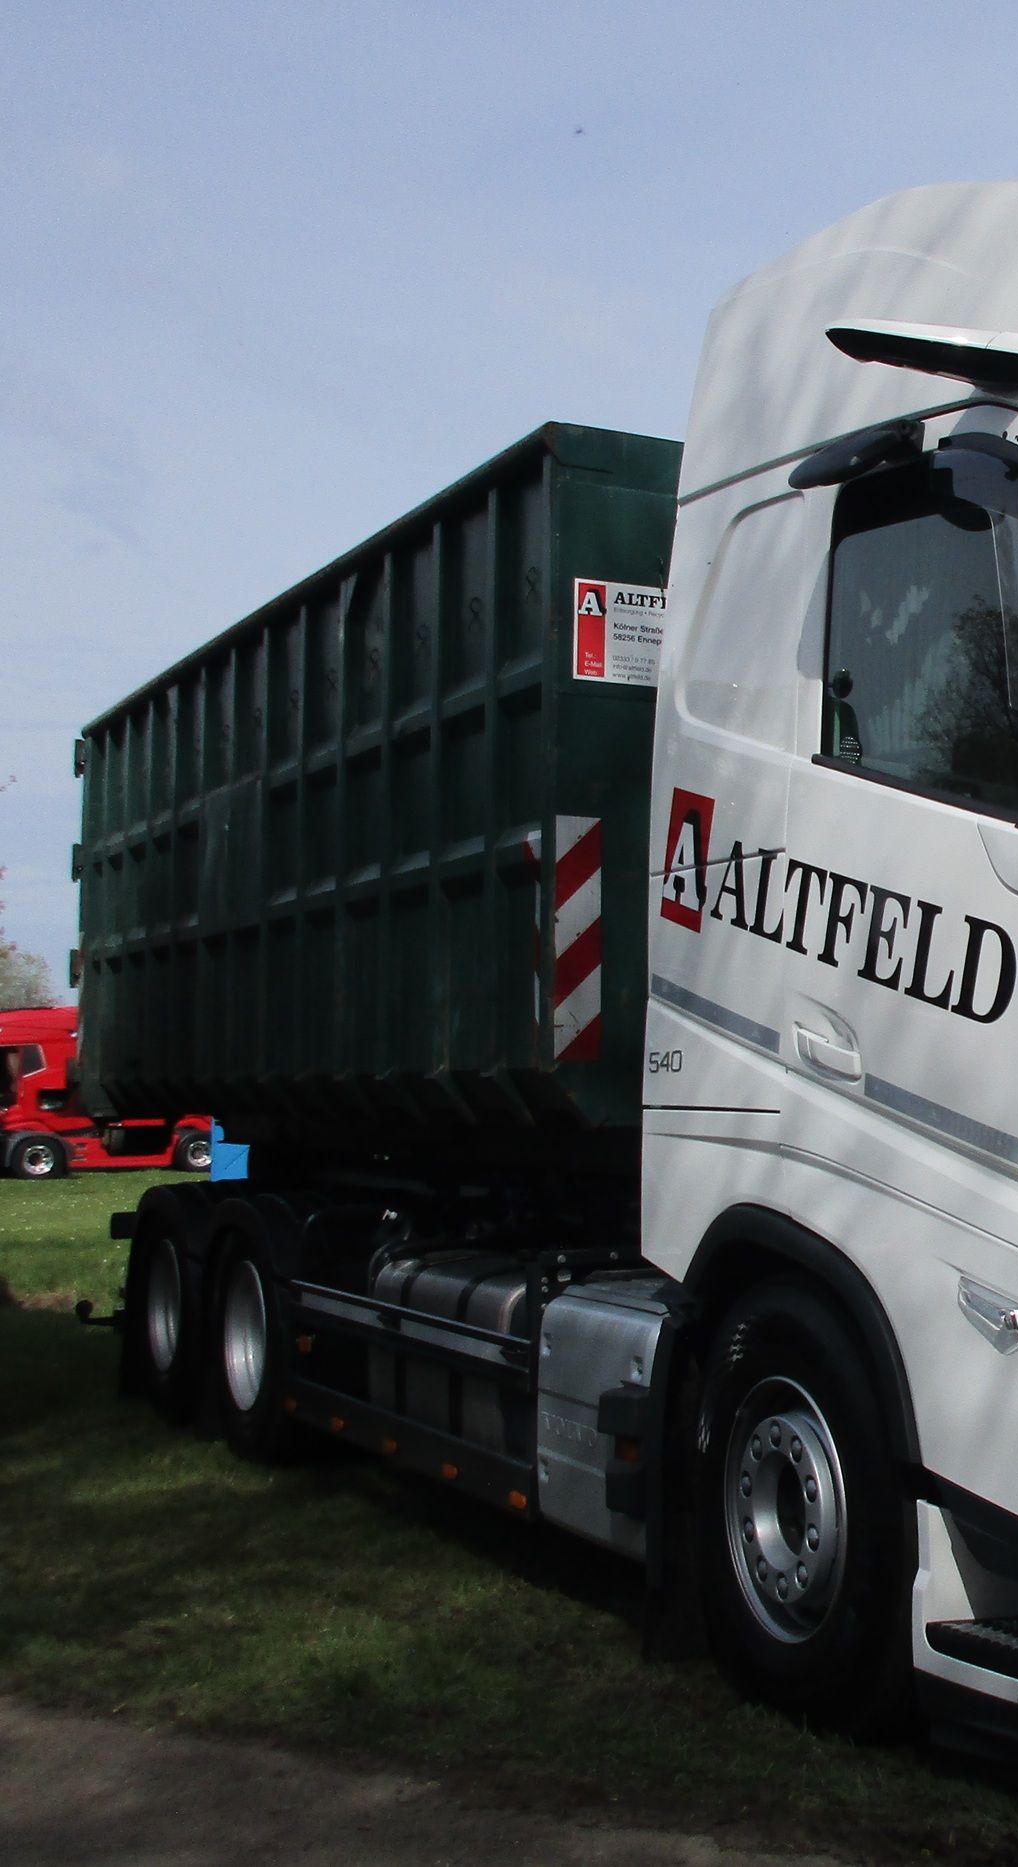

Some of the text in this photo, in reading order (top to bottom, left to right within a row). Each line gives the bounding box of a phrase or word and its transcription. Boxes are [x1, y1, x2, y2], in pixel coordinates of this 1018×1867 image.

[578, 588, 607, 617] A
[613, 621, 638, 632] Kölner
[613, 633, 636, 643] 58256
[663, 807, 1018, 1024] A ALTFELD
[649, 1050, 682, 1073] 540
